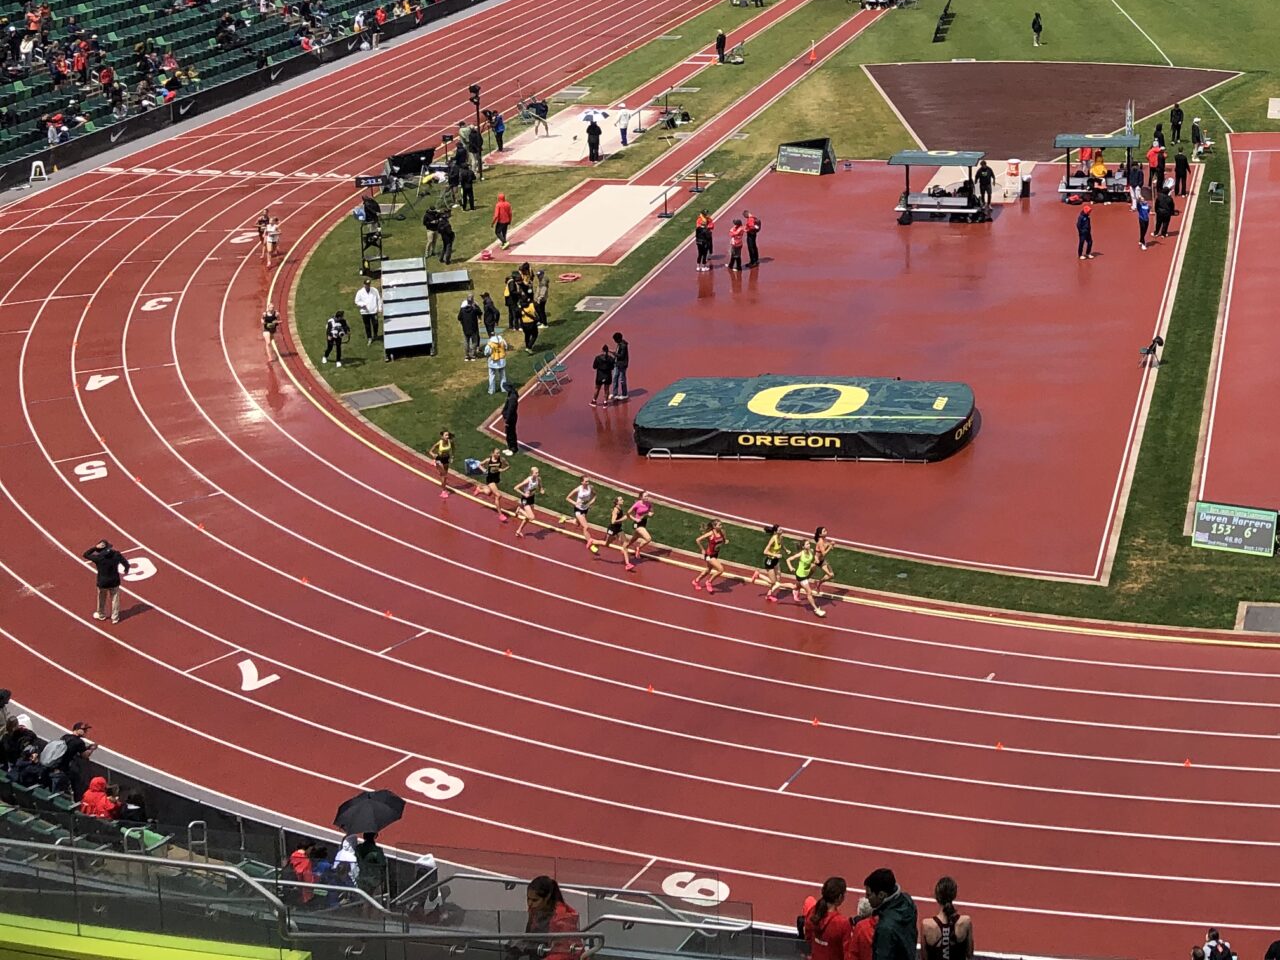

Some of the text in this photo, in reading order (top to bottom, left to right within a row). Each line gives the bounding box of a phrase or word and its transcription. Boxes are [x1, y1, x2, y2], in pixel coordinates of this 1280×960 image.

[141, 297, 173, 311] 3
[85, 374, 120, 391] 4
[737, 434, 841, 448] OREGON
[73, 460, 108, 482] 5
[1199, 512, 1228, 525] Deven
[237, 658, 281, 692] 7
[405, 767, 465, 800] 8
[661, 871, 731, 907] 9
